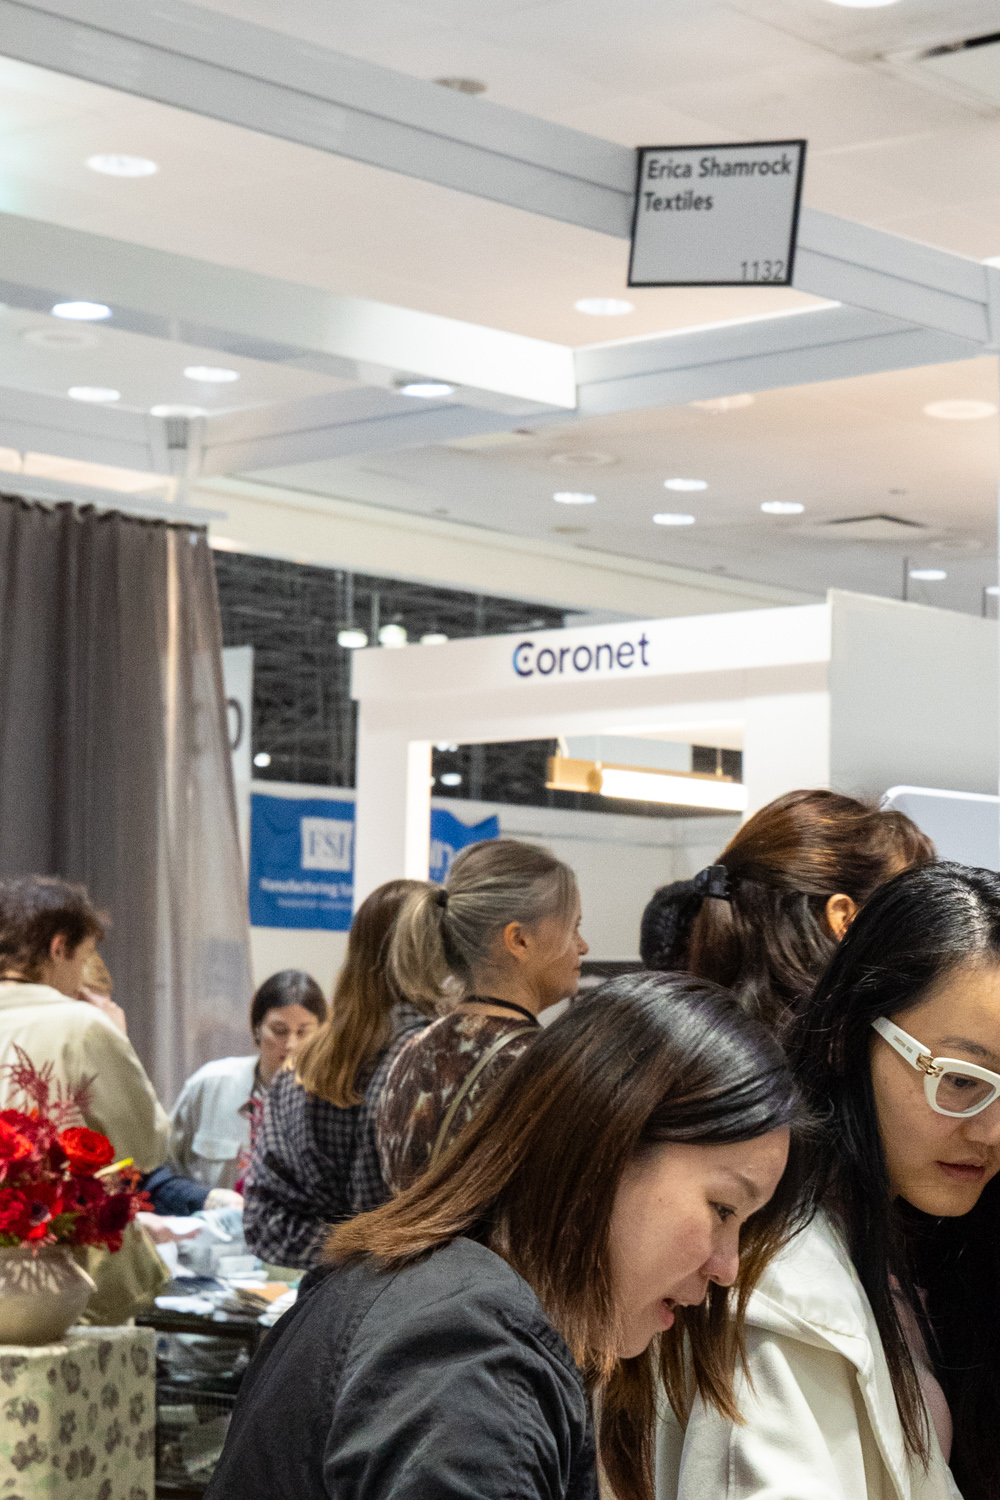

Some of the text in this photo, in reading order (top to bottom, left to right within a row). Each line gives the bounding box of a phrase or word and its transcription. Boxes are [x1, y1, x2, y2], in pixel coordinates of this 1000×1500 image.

[647, 153, 792, 179] Erica Shamrock
[644, 190, 713, 212] Textiles
[741, 260, 784, 282] 1132
[513, 633, 649, 677] Coronet
